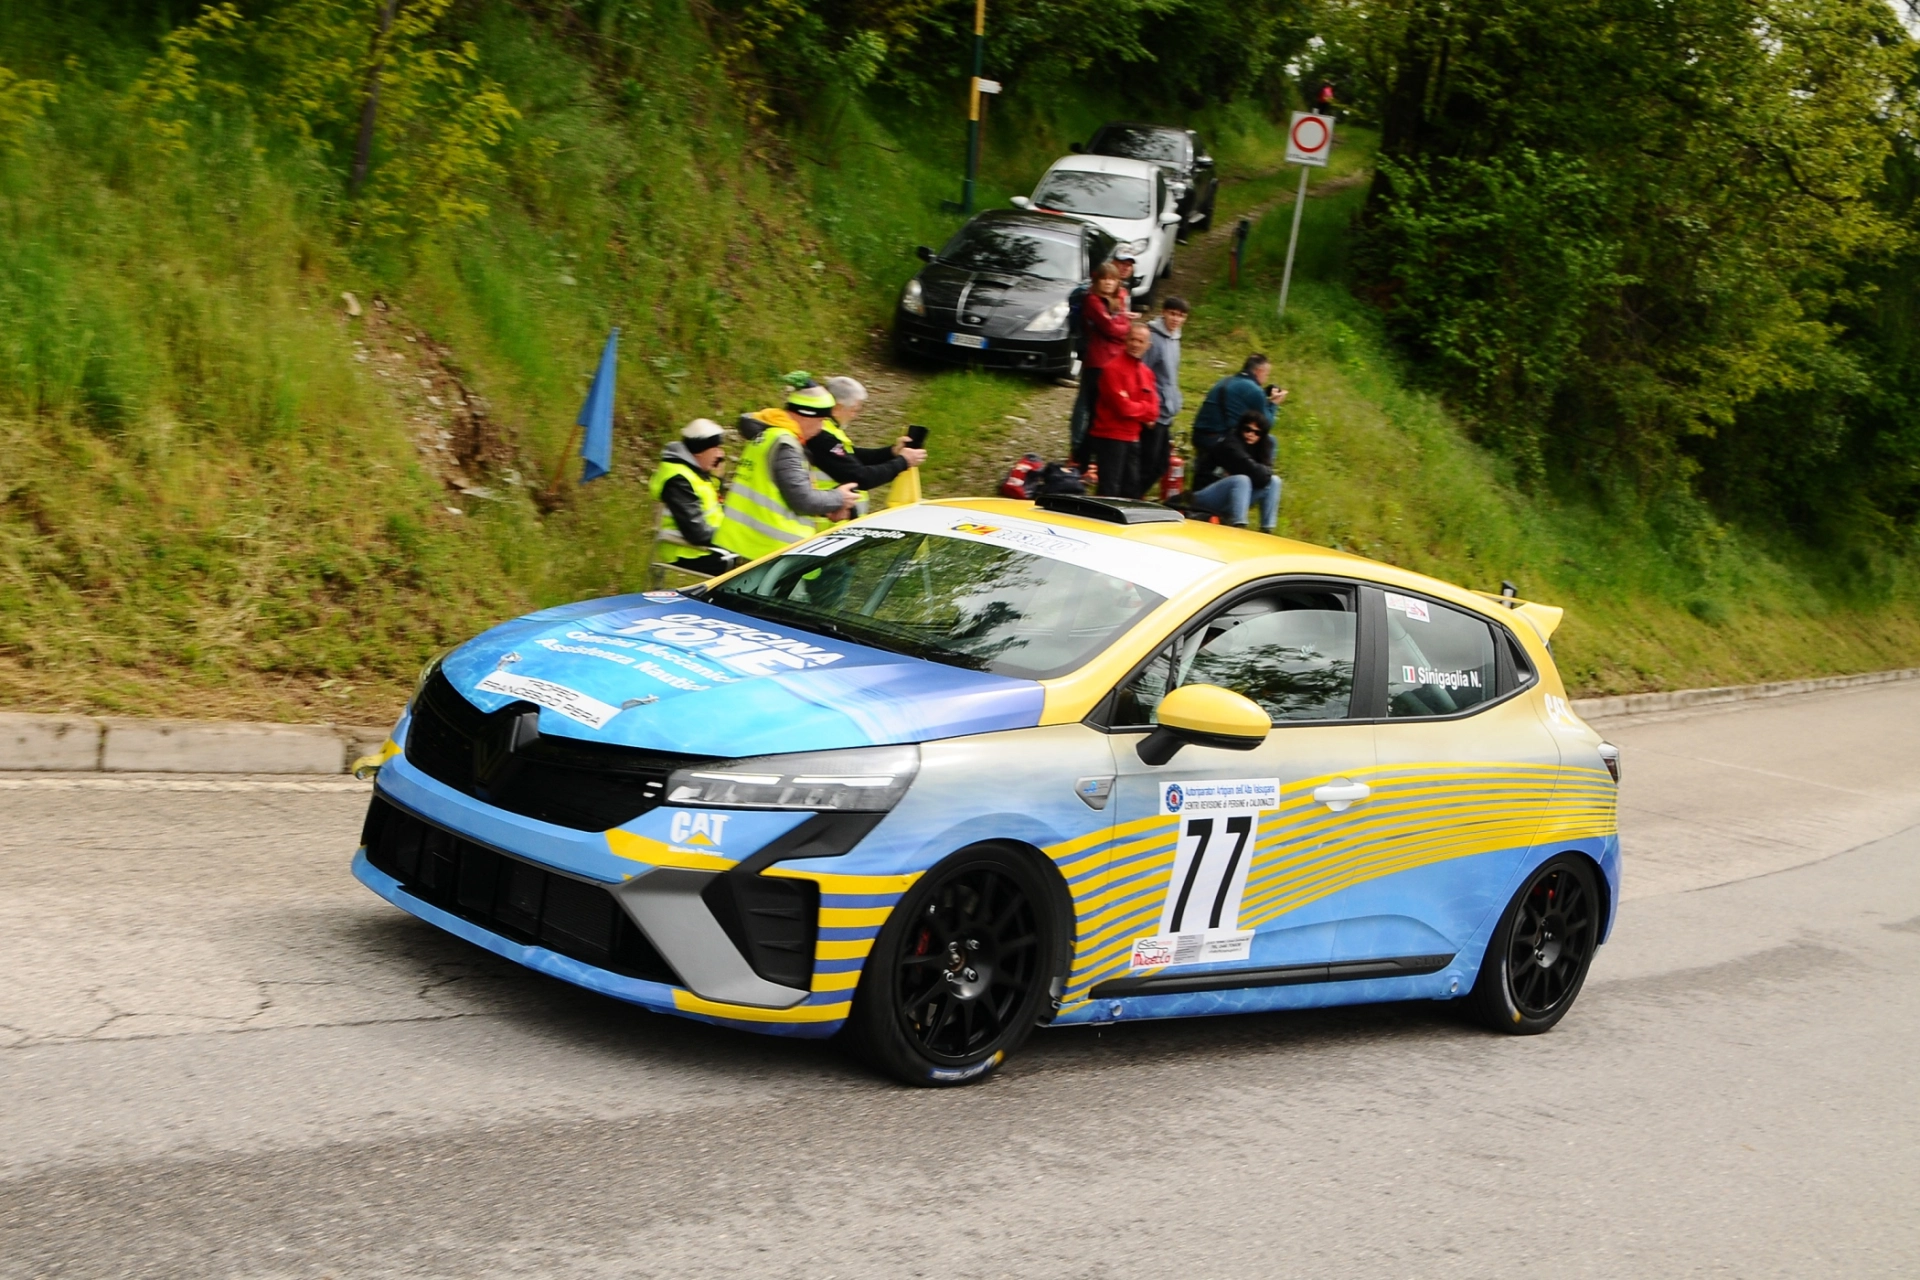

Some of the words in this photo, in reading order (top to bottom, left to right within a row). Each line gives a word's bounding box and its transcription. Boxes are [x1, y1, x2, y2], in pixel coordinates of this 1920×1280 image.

[535, 638, 636, 665] Assistenza
[661, 613, 845, 666] OFFICINA
[526, 679, 580, 702] TROFEO
[1417, 666, 1469, 690] Sinigaglia
[1469, 670, 1482, 688] N.
[562, 703, 601, 725] PERA
[670, 811, 729, 846] CAT
[1170, 816, 1252, 933] 77
